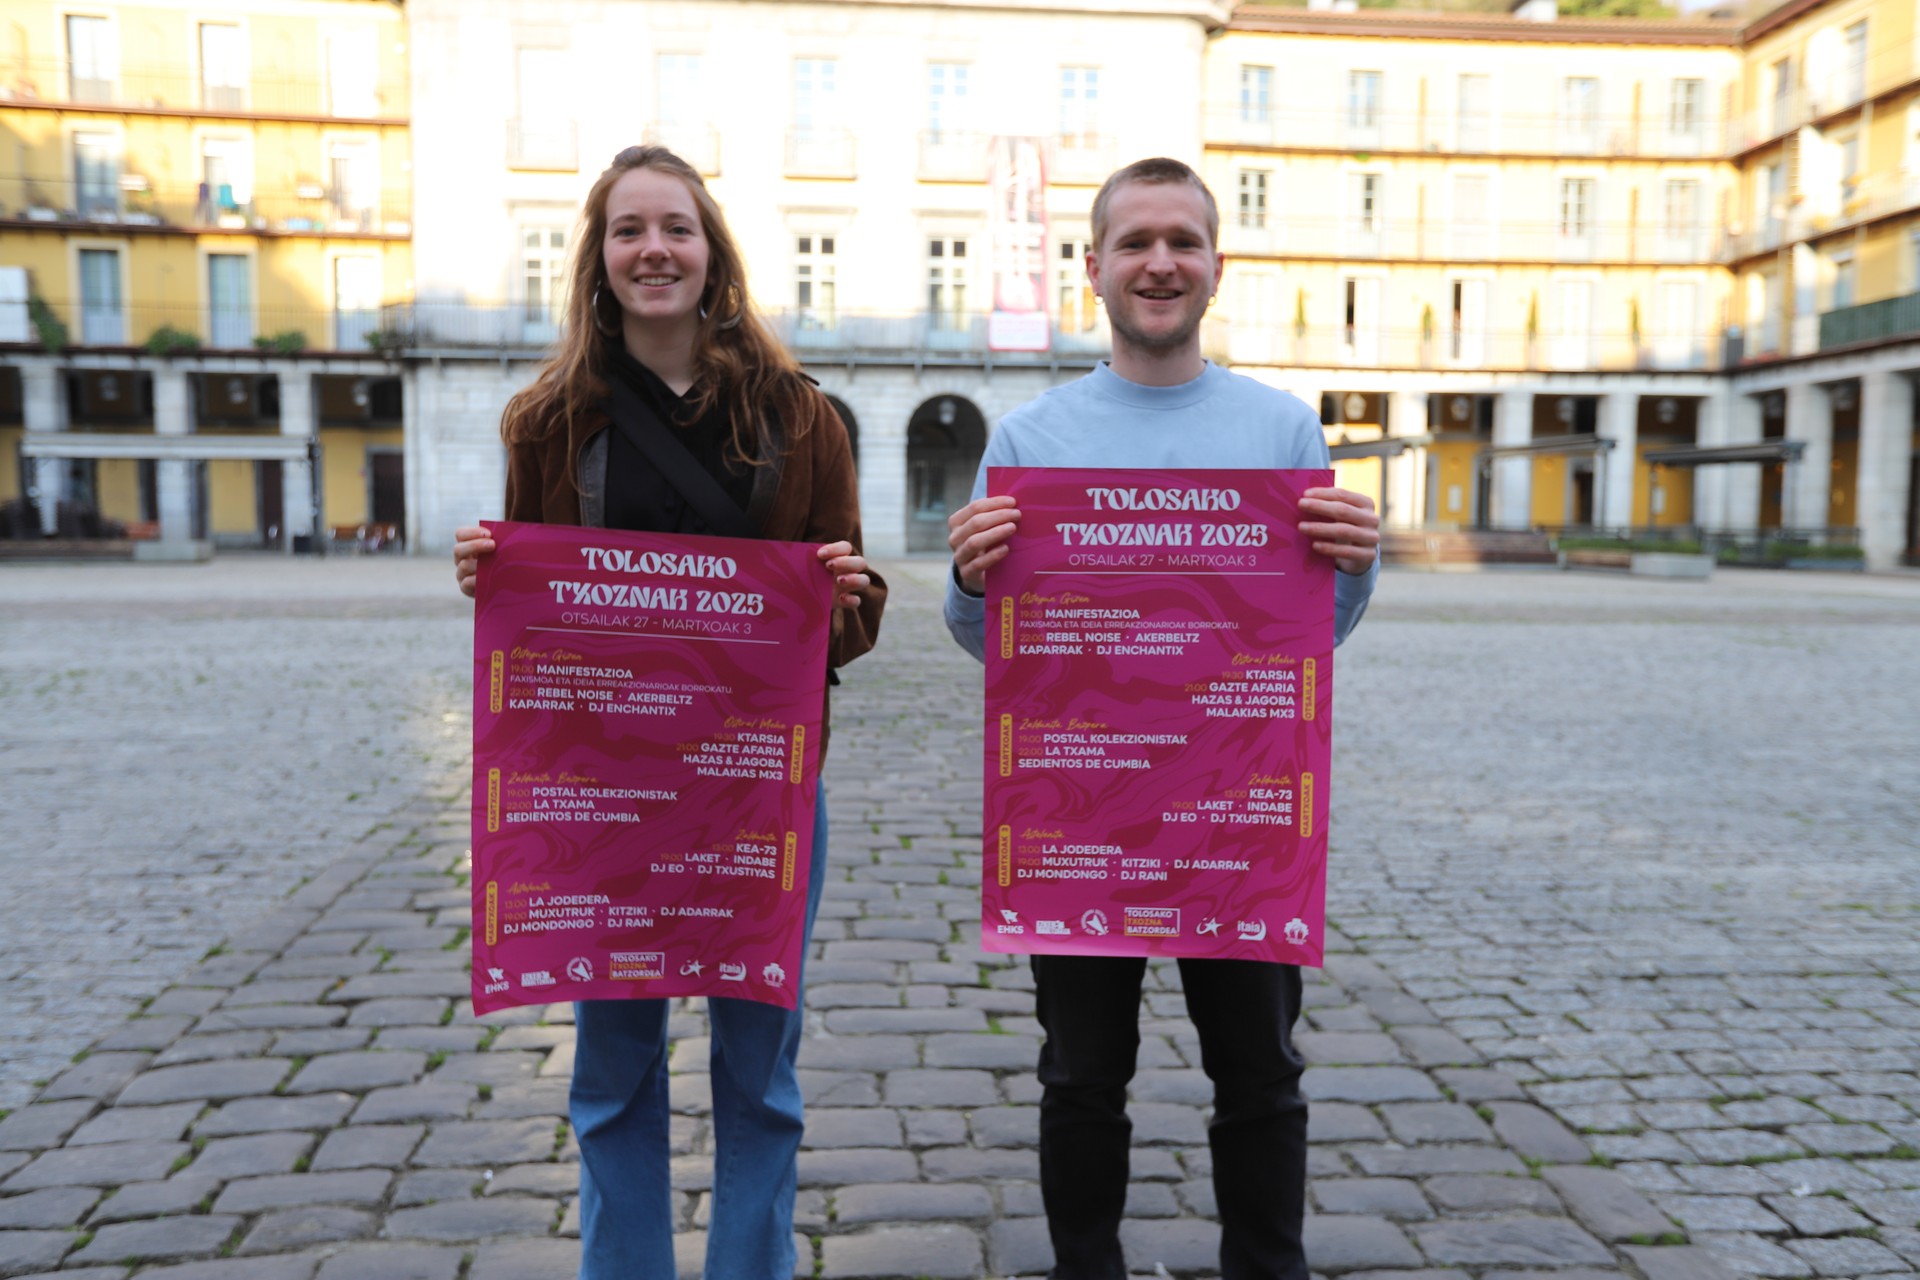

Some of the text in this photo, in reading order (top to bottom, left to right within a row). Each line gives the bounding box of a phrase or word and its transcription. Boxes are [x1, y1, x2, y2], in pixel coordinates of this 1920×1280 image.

[1086, 487, 1241, 511] TOLOSAKO
[1055, 523, 1269, 548] TXOZNAK 2025
[580, 547, 737, 579] TOLOSAKO
[1068, 554, 1257, 567] OTSAILAK 27 MARTXOAK 3
[548, 580, 764, 616] TXOZNAK 2025
[1045, 609, 1140, 619] MANIFESTAZIOA
[561, 611, 752, 634] OTSAILAK 27 MARTXOAK 3
[1020, 620, 1062, 629] FAXISMOA
[1064, 621, 1079, 629] ETA
[1081, 621, 1102, 629] IDEIA
[1104, 621, 1186, 629] ERREAKZIONARIOAK
[1046, 632, 1082, 642] REBEL
[1085, 632, 1121, 643] NOISE
[1134, 632, 1200, 643] AKERBELTZ
[1019, 645, 1184, 655] KAPARRAK DJ ENCHANTIX
[536, 664, 633, 679] MANIFESTAZIOA
[1245, 670, 1296, 681] KTARSIA
[510, 674, 554, 685] FAXISMOA
[555, 676, 571, 685] ETA
[573, 677, 595, 686] IDEIA
[596, 679, 680, 691] ERREAKZIONARIOAK
[1209, 682, 1249, 693] GAZTE
[1250, 683, 1296, 693] AFARIA
[537, 687, 693, 705] REBEL NOISE AKERBELTZ
[1191, 694, 1295, 706] HAZAS & JAGOBA
[509, 698, 676, 716] KAPARRAK DJ ENCHANTIX
[1206, 707, 1295, 719] MALAKIAS MX3
[737, 732, 786, 745] KTARSIA
[1043, 733, 1087, 744] POSTAL
[1090, 734, 1187, 745] KOLEKZIONISTAK
[700, 742, 785, 757] GAZTE AFARIA
[1045, 746, 1061, 756] LA
[1063, 746, 1106, 756] TXAMA
[683, 754, 784, 769] HAZAS & JAGOBA
[1018, 758, 1151, 769] SEDIENTOS DE CUMBIA
[697, 766, 783, 781] MALAKIAS MX3
[532, 786, 678, 801] POSTAL KOLEKZIONISTAK
[1249, 788, 1293, 800] KEA-73
[534, 799, 595, 810] LA TXAMA
[1197, 800, 1234, 811] LAKET
[1247, 802, 1292, 813] INDABE
[506, 811, 641, 823] SEDIENTOS DE CUMBIA
[1162, 812, 1292, 826] DJ EO DJ TXUSTIYAS
[736, 843, 777, 856] KEA-73
[1042, 845, 1058, 854] LA
[1060, 845, 1123, 855] JODEDERA
[684, 853, 776, 868] LAKET INDABE
[1042, 857, 1108, 867] MUXUTRUK
[1121, 858, 1161, 868] KITZIKI
[1174, 859, 1190, 869] DJ
[1192, 860, 1250, 871] ADARRAK
[650, 863, 776, 879] DJ EO DJ TXUSTIYAS
[1017, 869, 1168, 881] DJ MONDONGO DJ RANI
[529, 894, 610, 908] LA JODEDERA
[528, 906, 734, 920] MUXUTRUK KITZIKI DJ ADARRAK
[1127, 910, 1173, 918] TOLOSAKO
[504, 918, 654, 934] DJ MONDONGO DJ RANI
[997, 925, 1024, 935] EHKS
[1127, 926, 1177, 934] BATZORDEA
